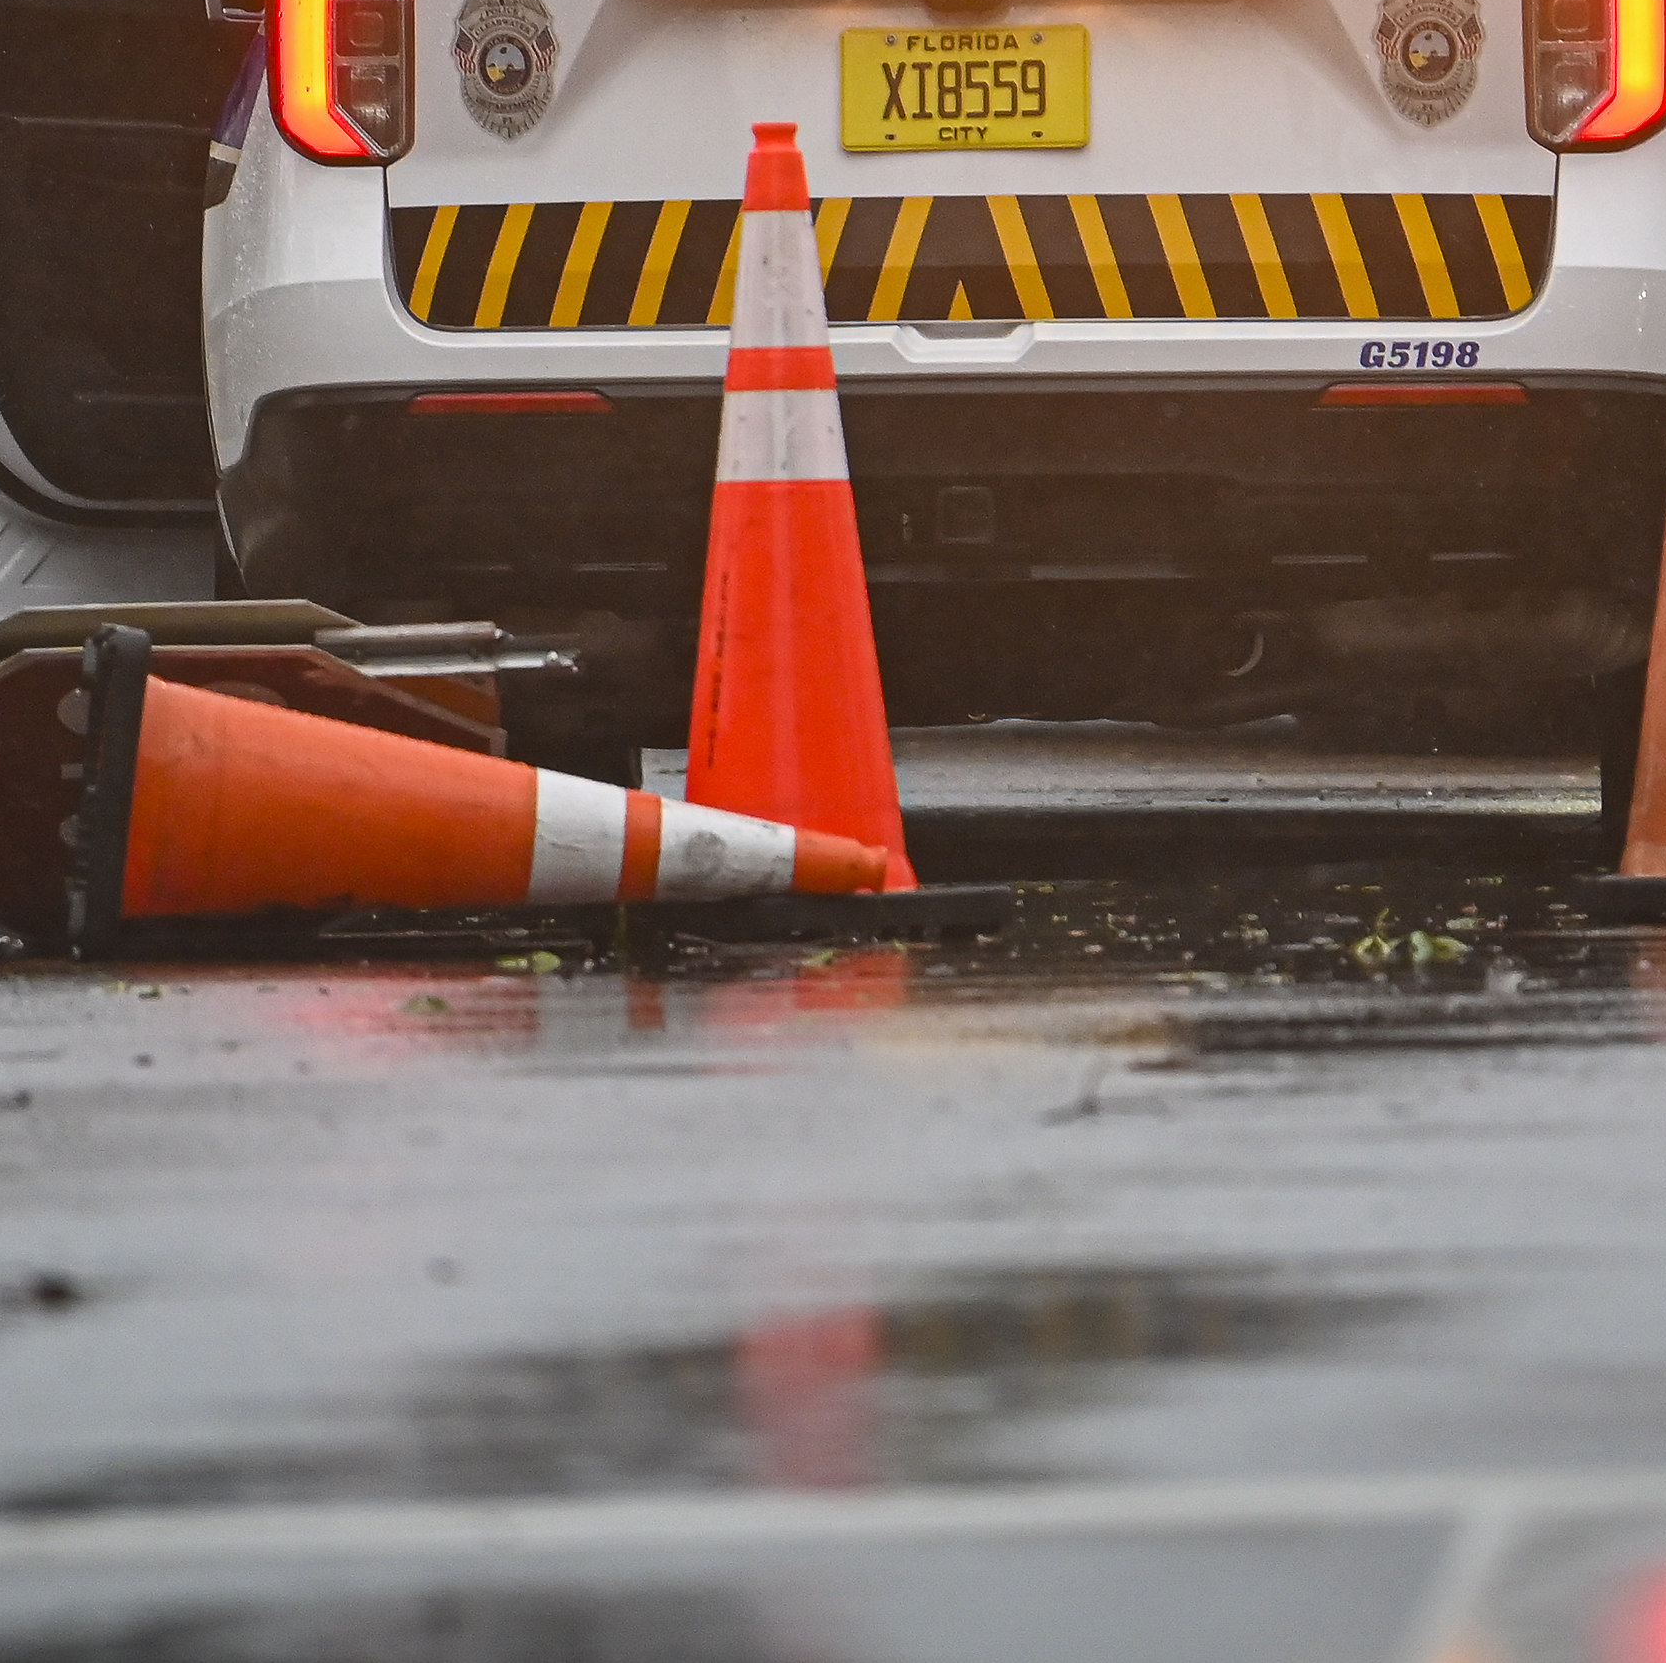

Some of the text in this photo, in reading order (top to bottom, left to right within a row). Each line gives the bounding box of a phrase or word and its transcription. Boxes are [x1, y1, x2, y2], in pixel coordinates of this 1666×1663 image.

[906, 34, 1020, 52] FLORIDA
[882, 60, 1046, 120] XI8559
[938, 126, 989, 141] CITY
[1359, 341, 1481, 369] G5198
